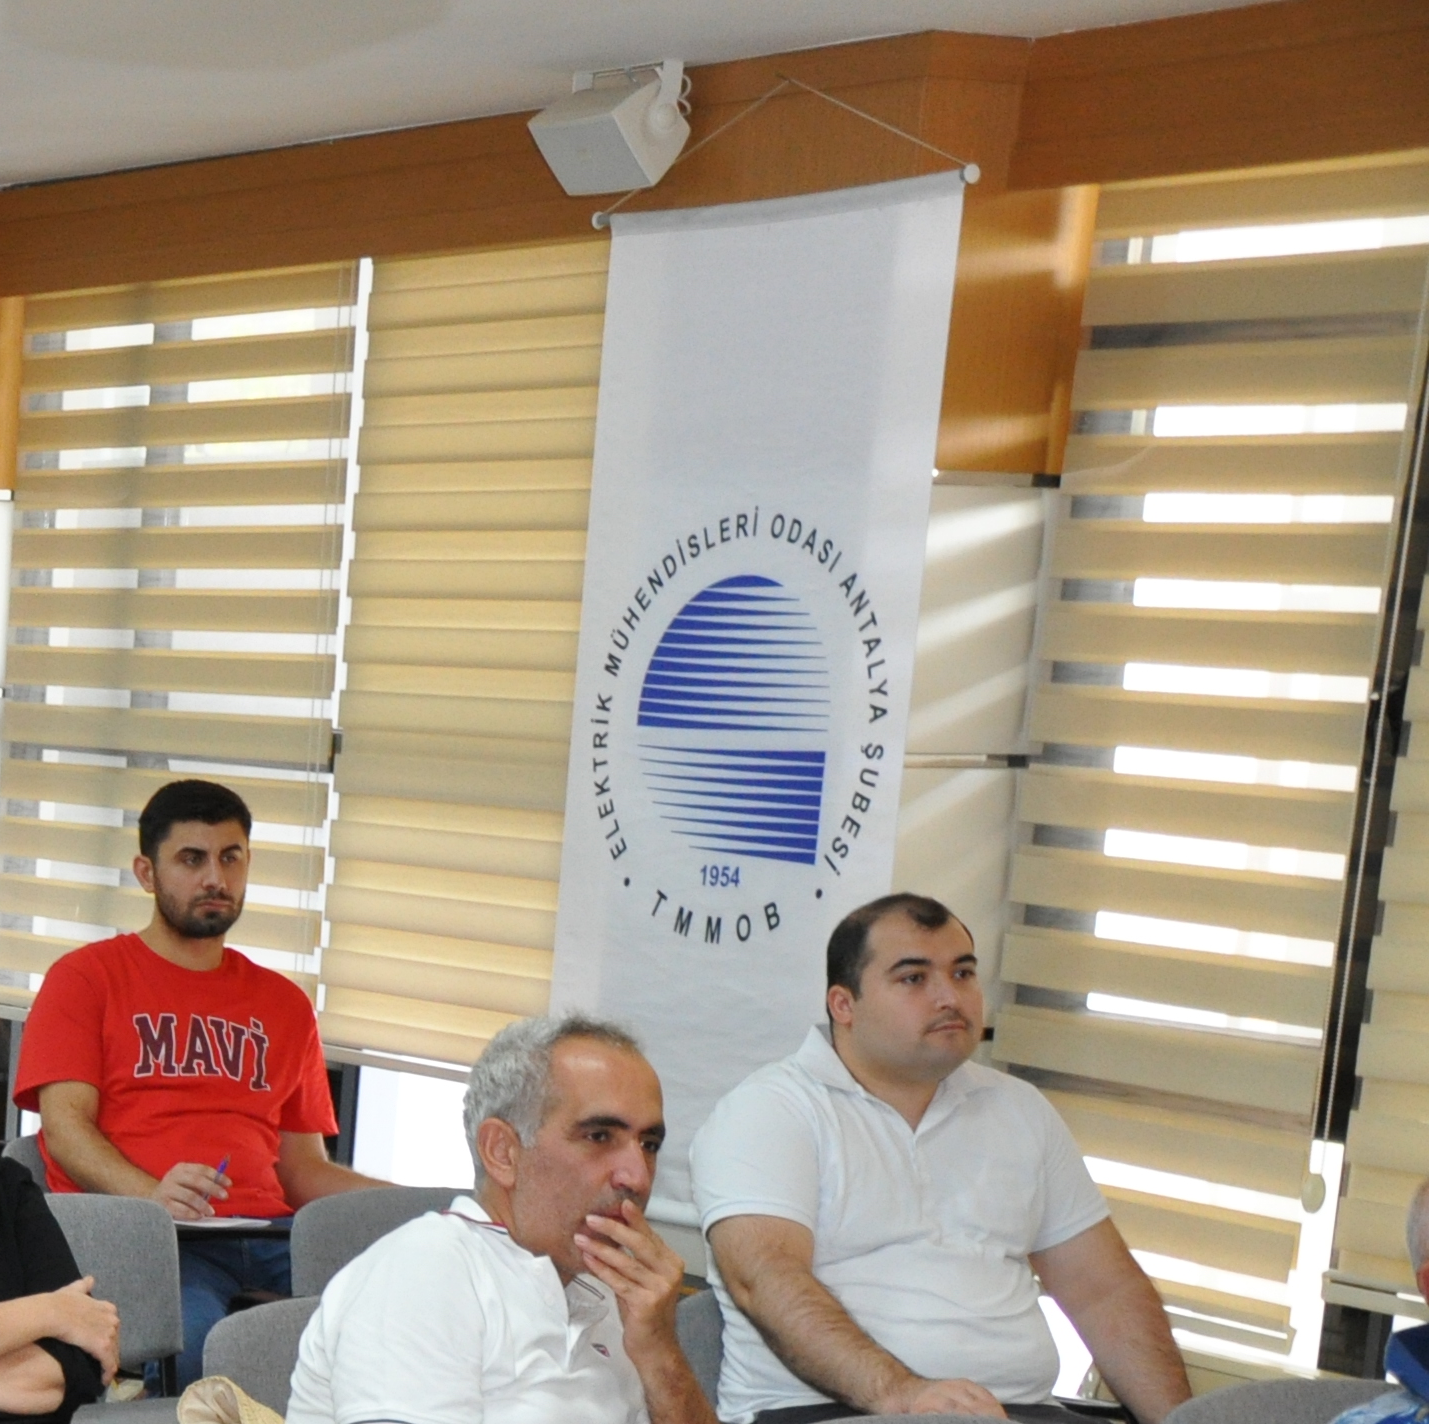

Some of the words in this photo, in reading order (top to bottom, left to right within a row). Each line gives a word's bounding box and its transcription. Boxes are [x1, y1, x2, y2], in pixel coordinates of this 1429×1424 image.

[603, 505, 760, 678] MÜHENDİSLERİ
[770, 512, 843, 573] ODASI
[839, 573, 889, 724] ANTALYA
[590, 693, 628, 861] ELEKTRİK
[824, 743, 884, 876] ŞUBESİ
[649, 889, 781, 945] TMMOB
[699, 864, 742, 888] 1954
[132, 1012, 272, 1093] MAVİ
